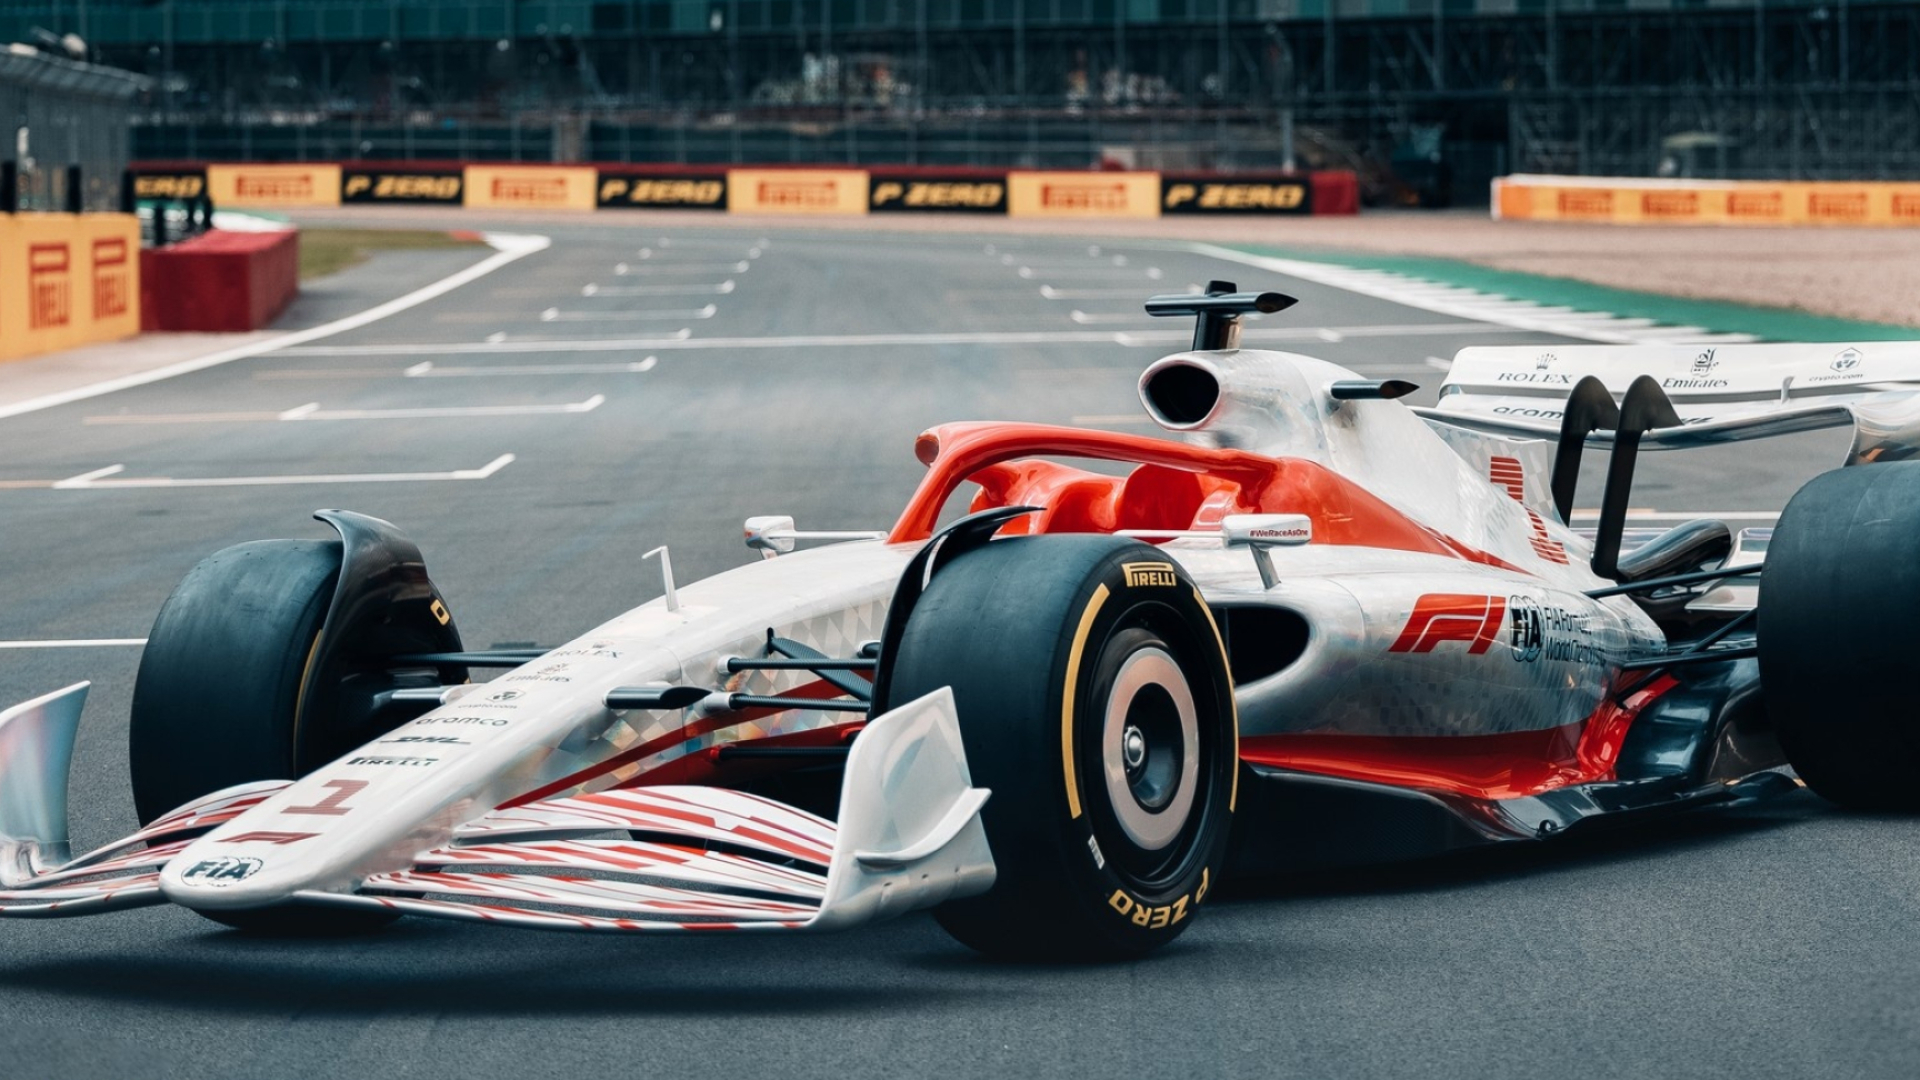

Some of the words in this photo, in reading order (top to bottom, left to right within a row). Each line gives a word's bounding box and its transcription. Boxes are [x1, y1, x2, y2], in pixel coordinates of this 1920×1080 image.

[374, 176, 460, 199] ZERO
[600, 180, 628, 201] P
[630, 180, 723, 203] ZERO
[873, 182, 902, 204] P
[904, 182, 1003, 206] ZERO
[1165, 184, 1197, 207] P
[1198, 184, 1305, 207] ZERO
[1497, 372, 1574, 384] ROLEX
[1662, 377, 1729, 388] Emirates
[1122, 561, 1177, 587] PIRELLI
[415, 716, 509, 727] aramco
[346, 755, 439, 767] PIRELLI
[280, 779, 370, 816] 1
[183, 861, 251, 880] FIA
[1108, 889, 1190, 929] ZERO
